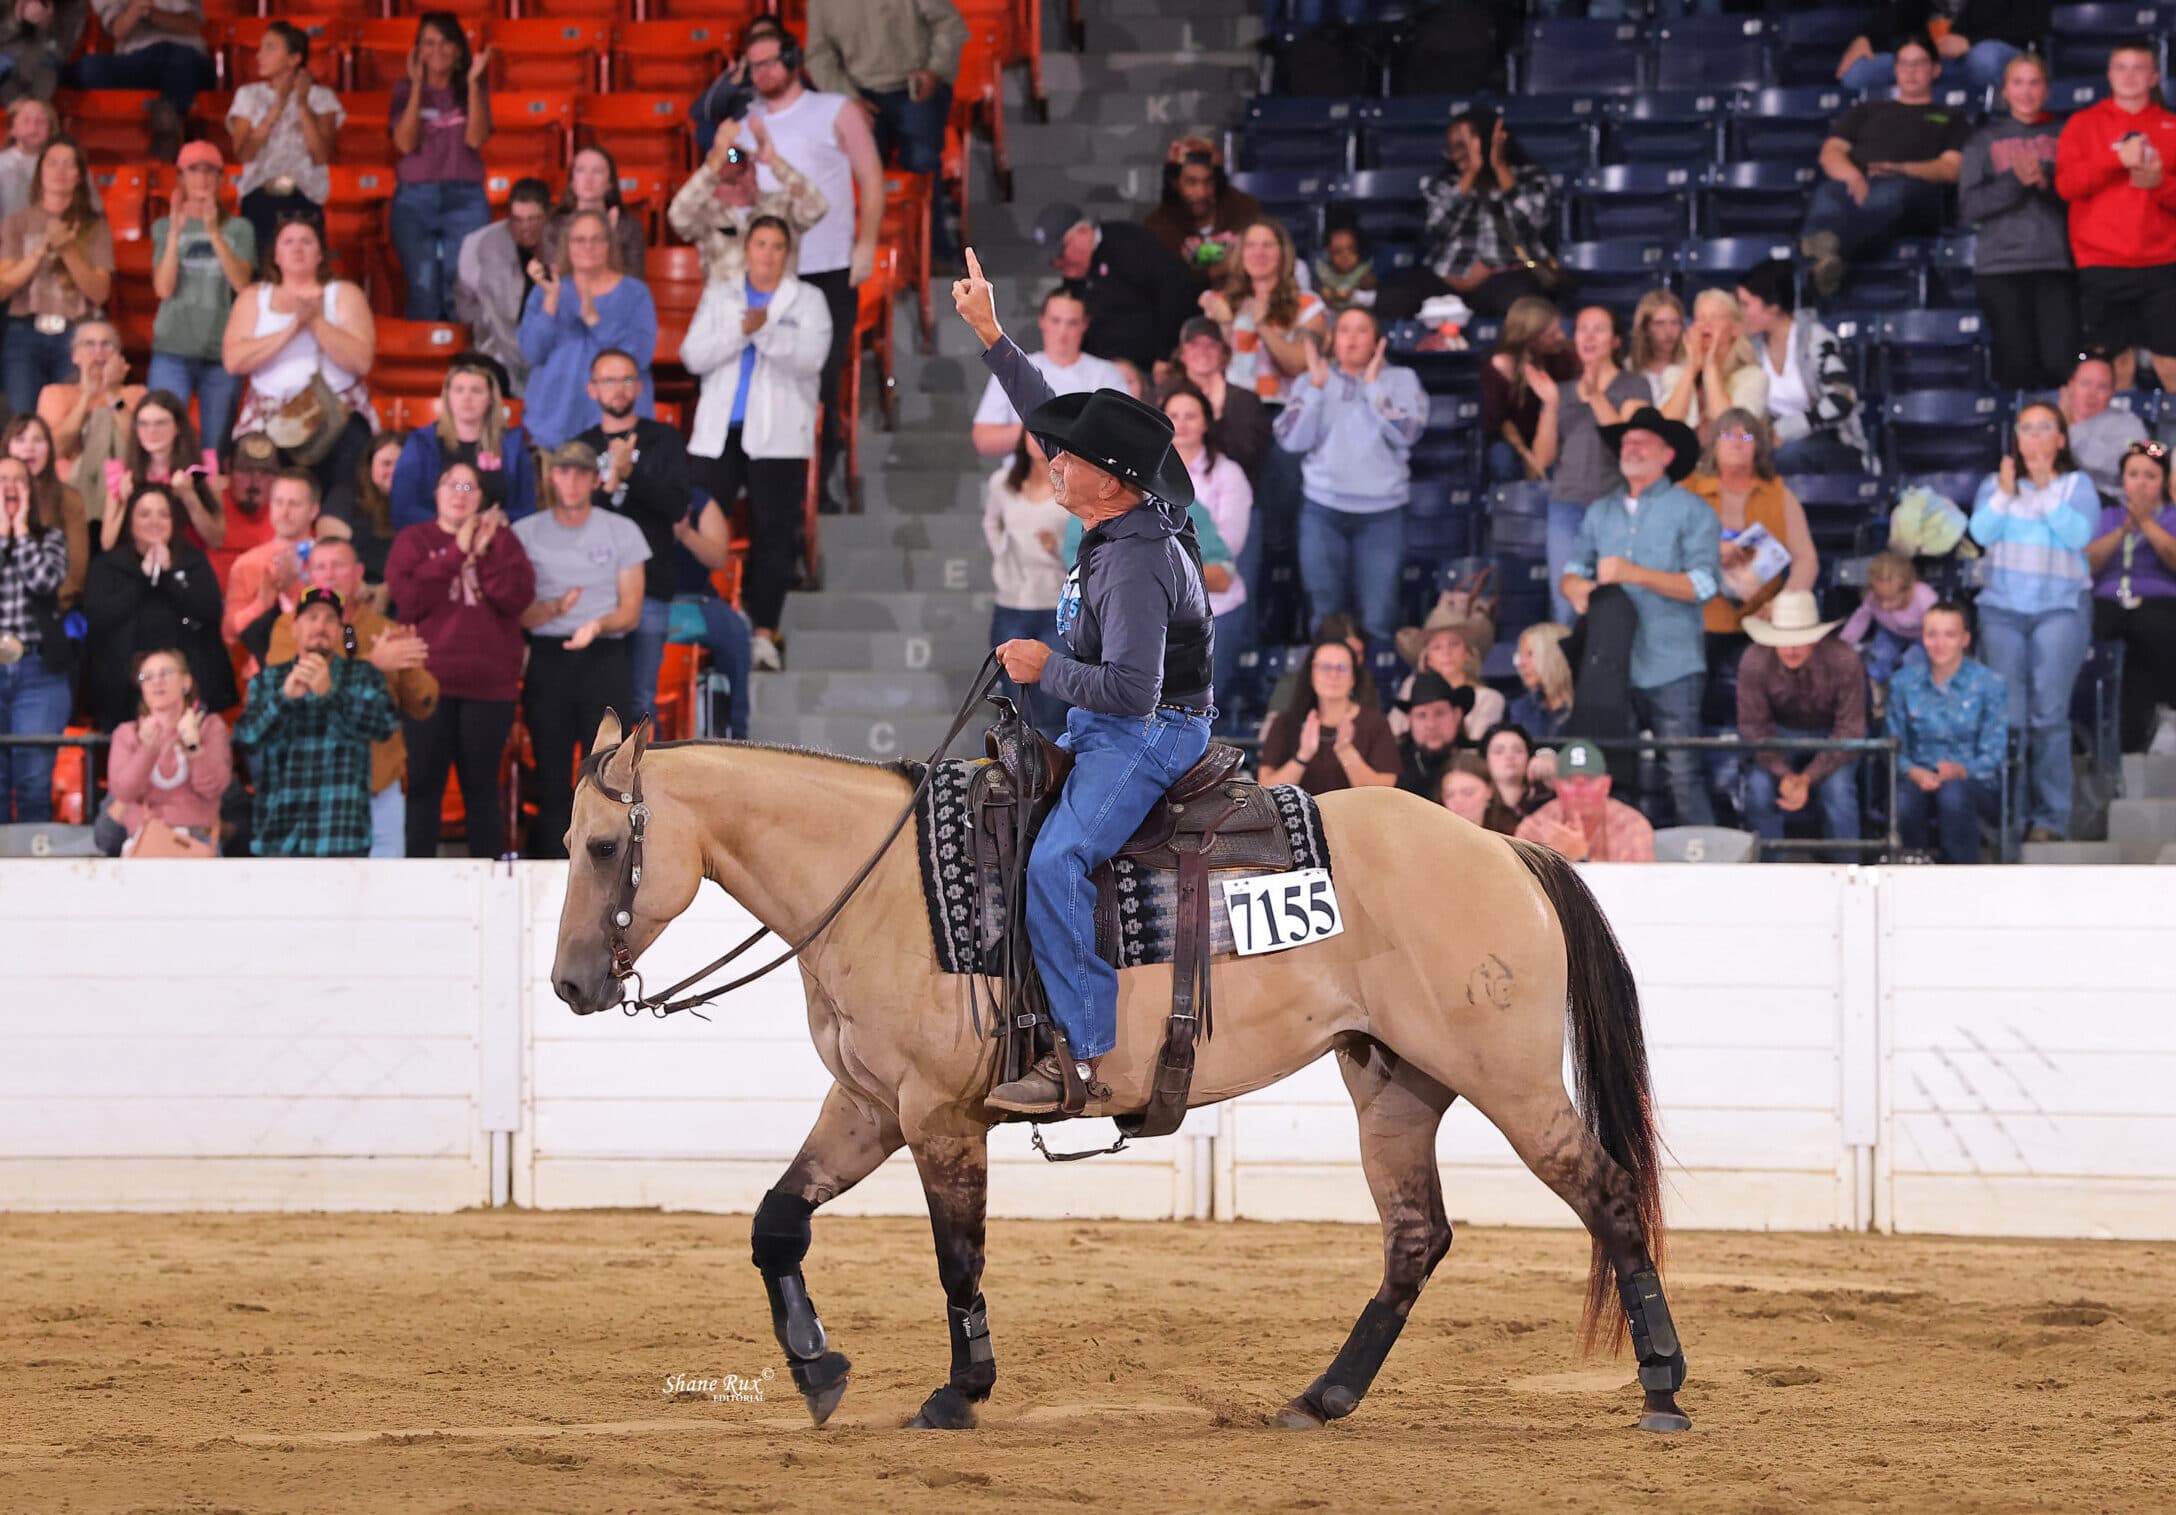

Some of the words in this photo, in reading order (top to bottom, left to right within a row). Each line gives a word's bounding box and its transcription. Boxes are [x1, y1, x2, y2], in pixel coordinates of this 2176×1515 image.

[1147, 95, 1171, 124] K
[1117, 168, 1139, 199] J
[944, 558, 969, 589] E
[906, 636, 931, 669] D
[869, 721, 896, 753] C
[31, 834, 50, 856] 6
[1230, 880, 1336, 951] 7155
